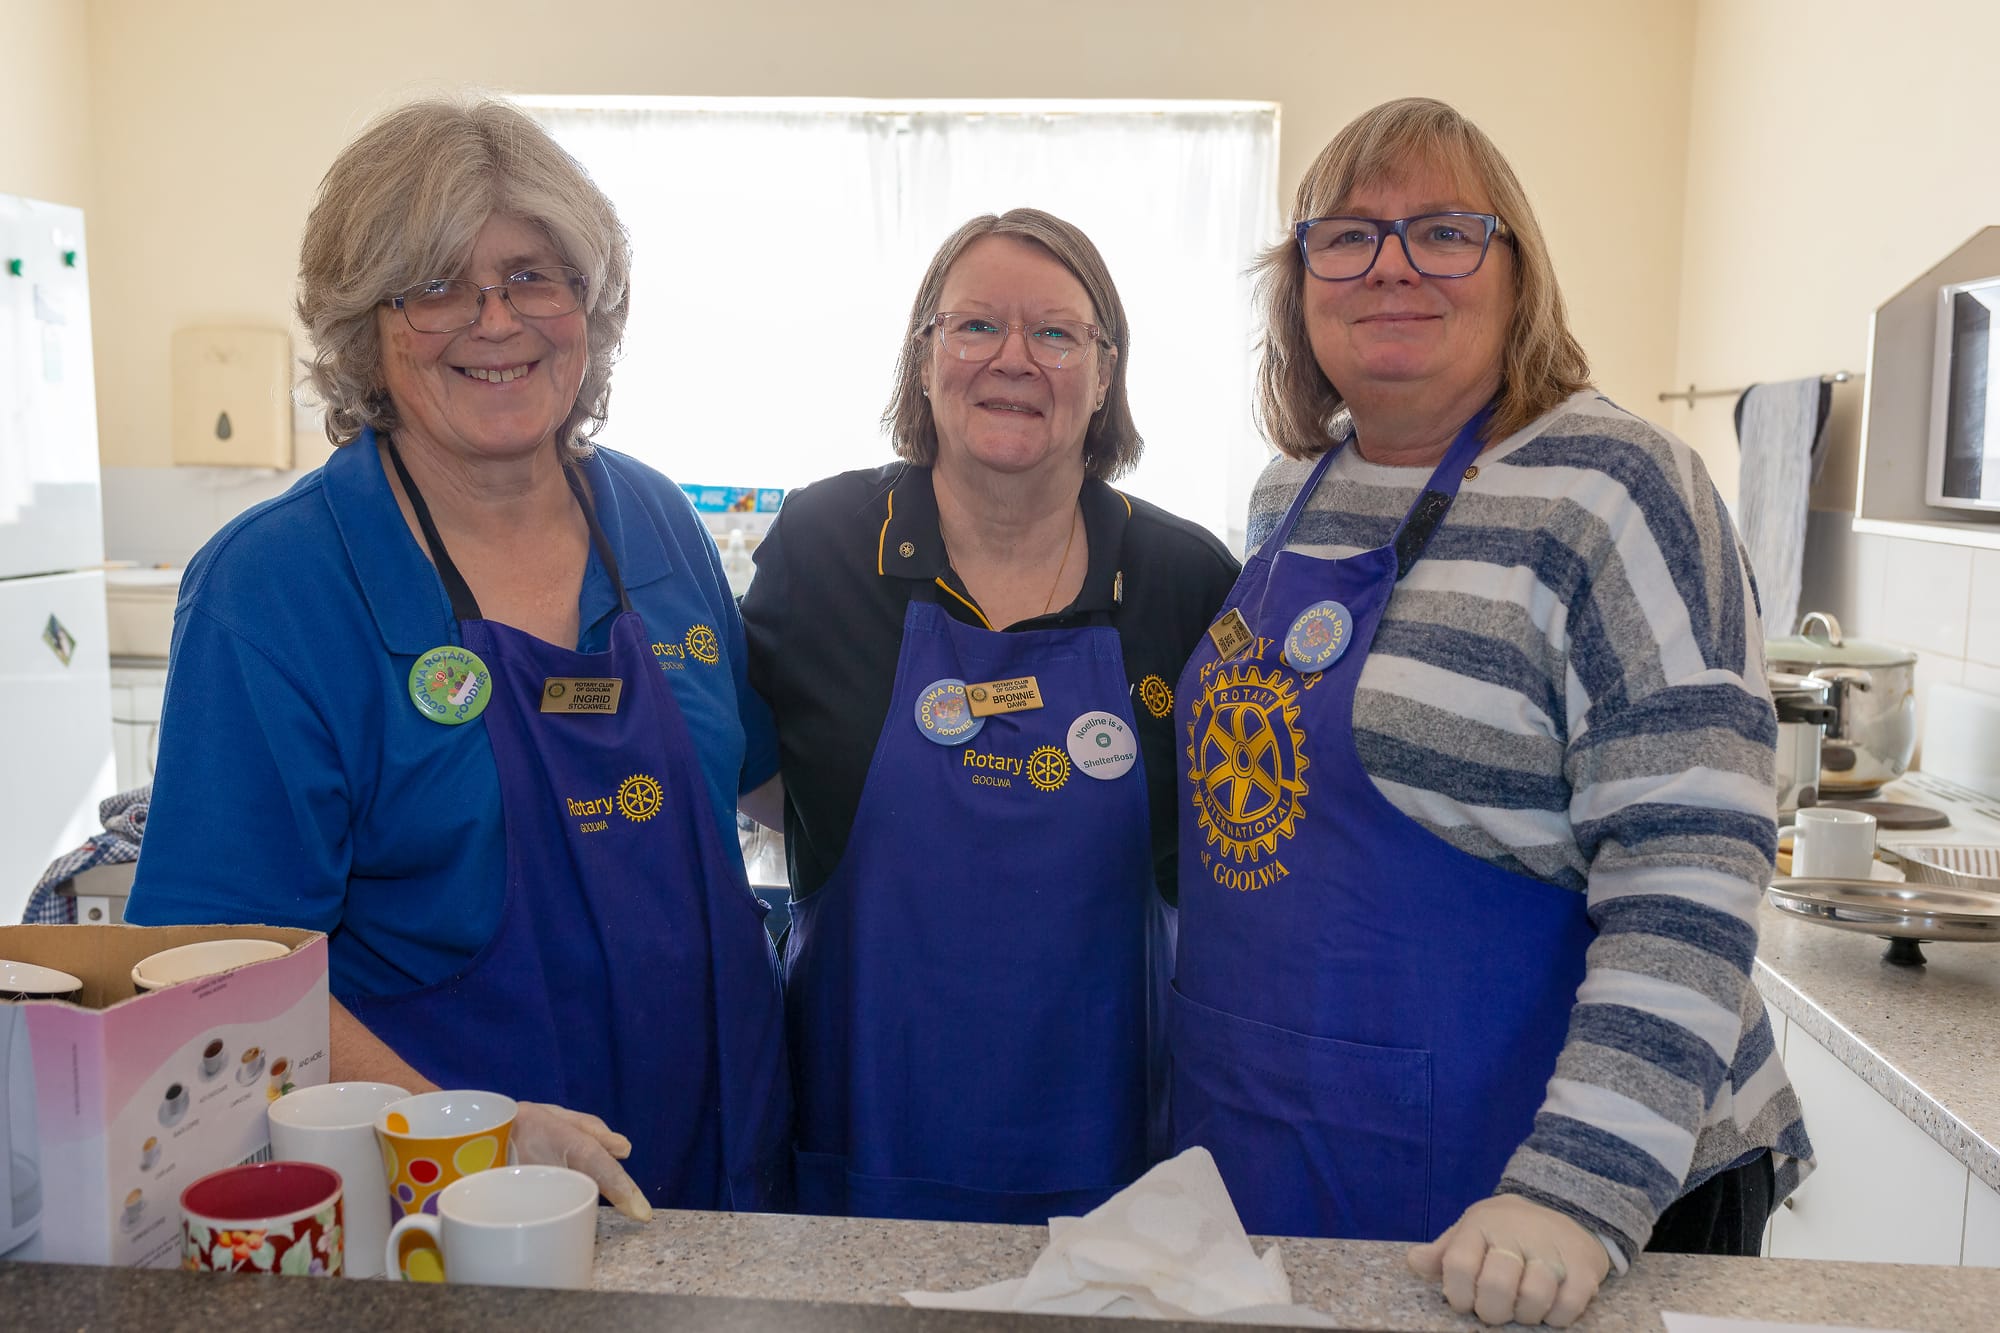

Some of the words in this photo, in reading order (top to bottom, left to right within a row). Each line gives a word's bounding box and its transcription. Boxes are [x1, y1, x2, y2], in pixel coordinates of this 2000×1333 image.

[1293, 607, 1337, 631] GOOLWA
[1316, 619, 1343, 663] ROTARY
[424, 650, 474, 668] ROTARY
[651, 641, 686, 659] otary
[1291, 636, 1312, 663] FOODIES
[415, 669, 447, 714] GOOLWA
[455, 671, 489, 720] FOODIES
[573, 694, 611, 704] INGRID
[992, 690, 1036, 704] BRONNIE
[1219, 689, 1275, 705] ROTARY
[921, 687, 946, 730] GOOLWA
[1006, 700, 1027, 709] DAWS
[1075, 718, 1107, 739] Noeline
[1108, 718, 1117, 727] is
[1116, 724, 1123, 732] a
[963, 749, 1023, 776] Rotary
[1083, 752, 1134, 769] ShelterBoss
[971, 774, 1012, 788] GOOLWA
[566, 796, 613, 817] Rotary
[1203, 788, 1291, 838] INTERNATIONAL
[580, 820, 609, 833] GOOLWA
[1213, 859, 1291, 892] GOOLWA
